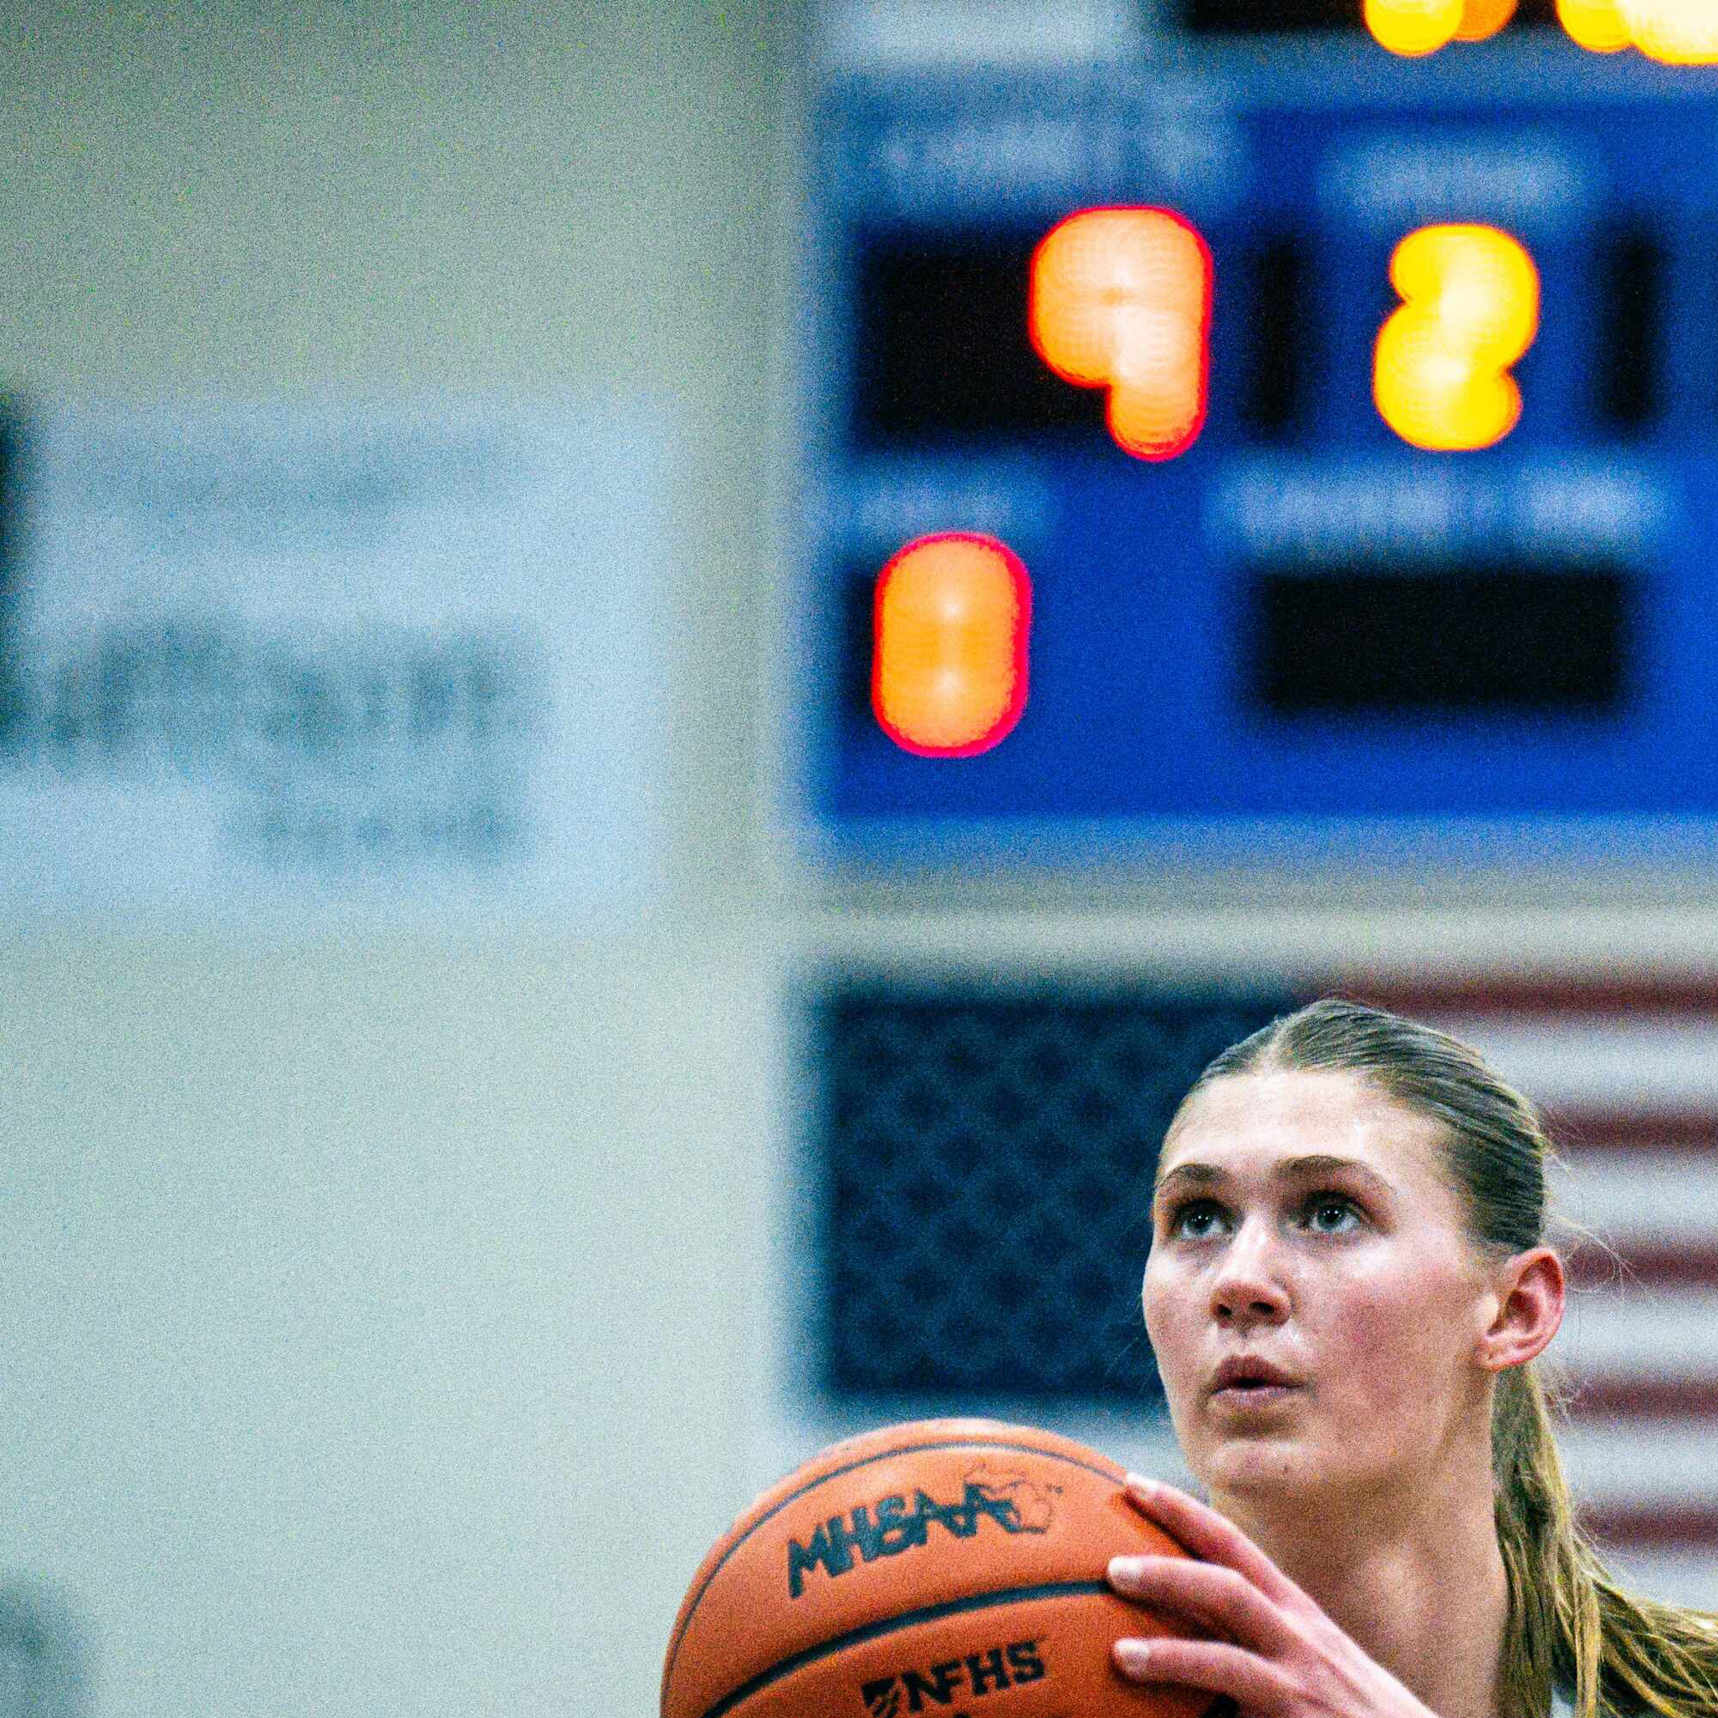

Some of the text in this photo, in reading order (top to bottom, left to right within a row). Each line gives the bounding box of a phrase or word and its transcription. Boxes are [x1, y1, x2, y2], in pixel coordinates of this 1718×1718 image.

[1029, 205, 1213, 461] 9
[787, 1483, 1021, 1599] MHSAA
[900, 1639, 1046, 1713] NFHS
